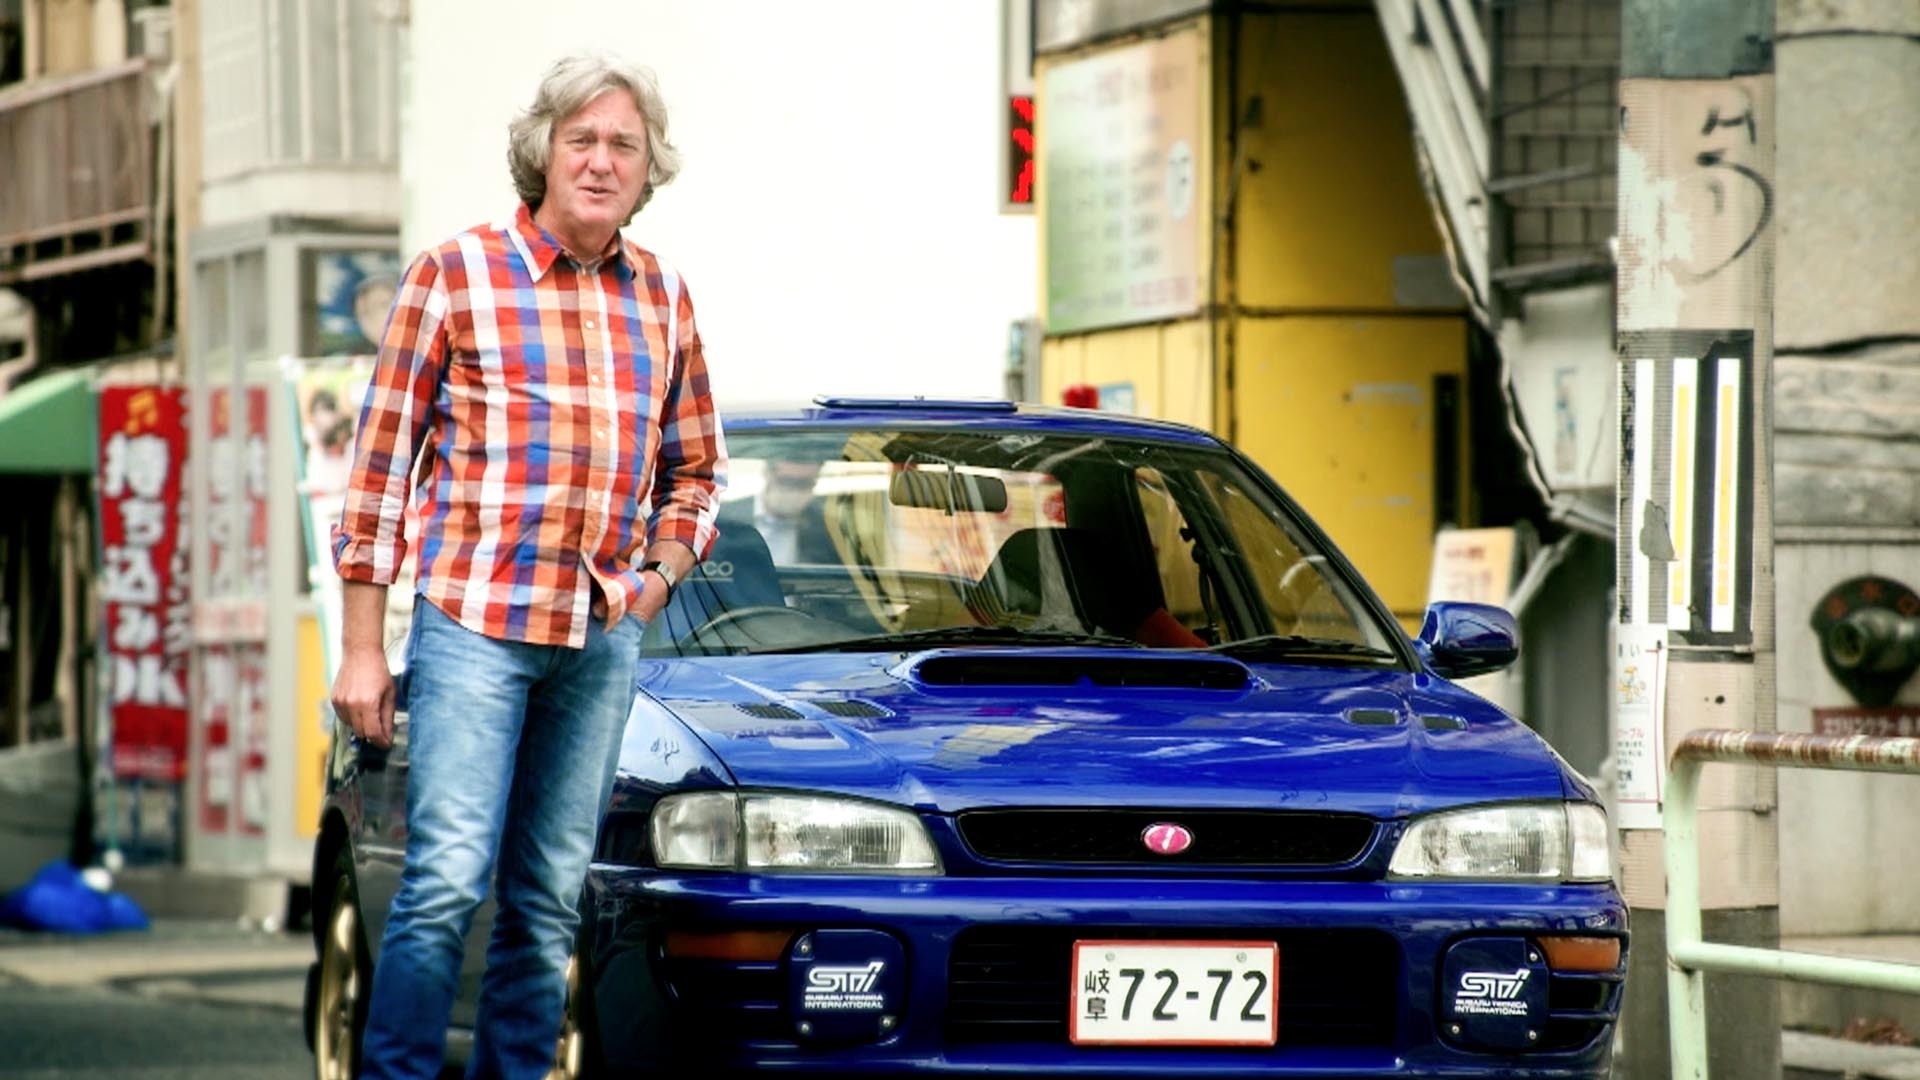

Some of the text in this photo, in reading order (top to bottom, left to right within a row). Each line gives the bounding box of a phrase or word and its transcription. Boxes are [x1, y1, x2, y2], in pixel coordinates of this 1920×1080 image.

[1084, 968, 1110, 1022] 岐阜
[1119, 968, 1268, 1022] 72-72
[804, 1001, 884, 1009] INTERNATIONAL
[1456, 999, 1491, 1007] SUBARU
[1454, 1006, 1527, 1016] INTERNATIONAL
